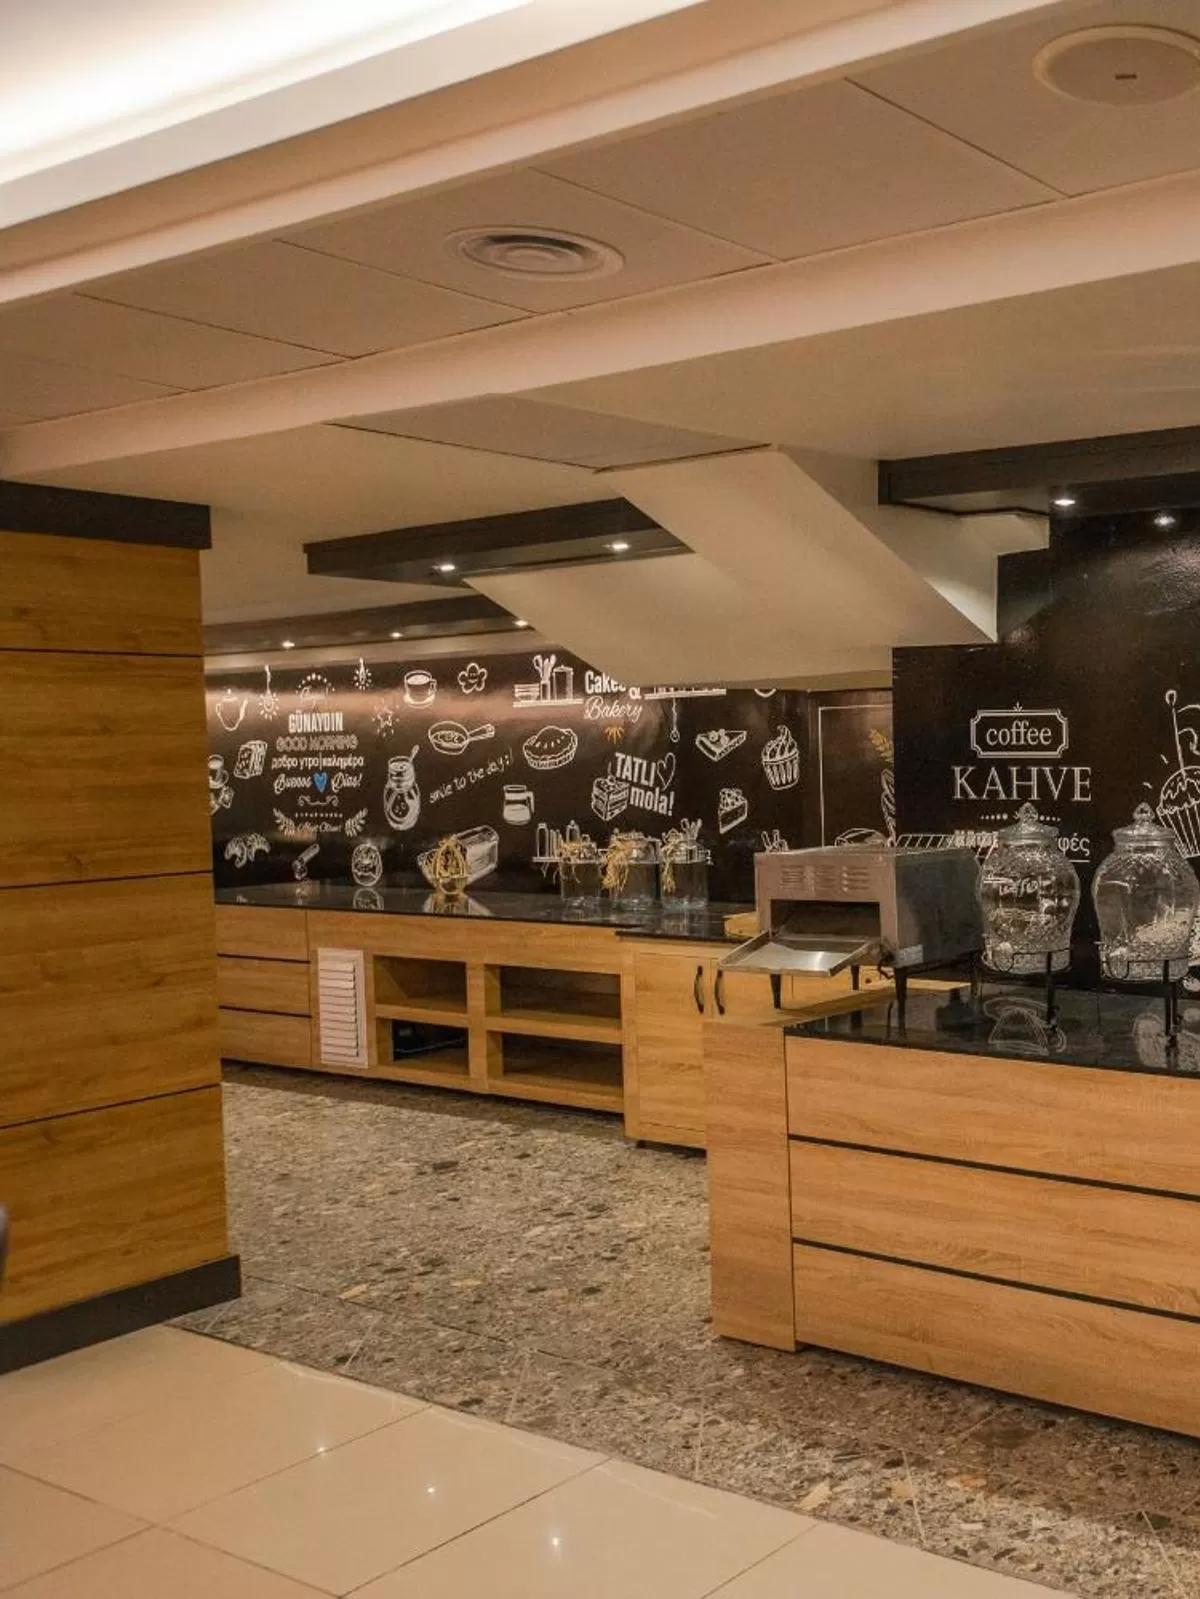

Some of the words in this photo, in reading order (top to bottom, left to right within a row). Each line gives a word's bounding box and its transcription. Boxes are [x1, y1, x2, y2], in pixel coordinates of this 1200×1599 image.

[288, 709, 344, 733] GÜNAYDIN
[584, 695, 642, 723] Bakery
[986, 720, 1052, 746] coffee
[615, 751, 657, 787] TATLI
[951, 766, 1092, 801] KAHVE
[630, 786, 675, 816] mola!
